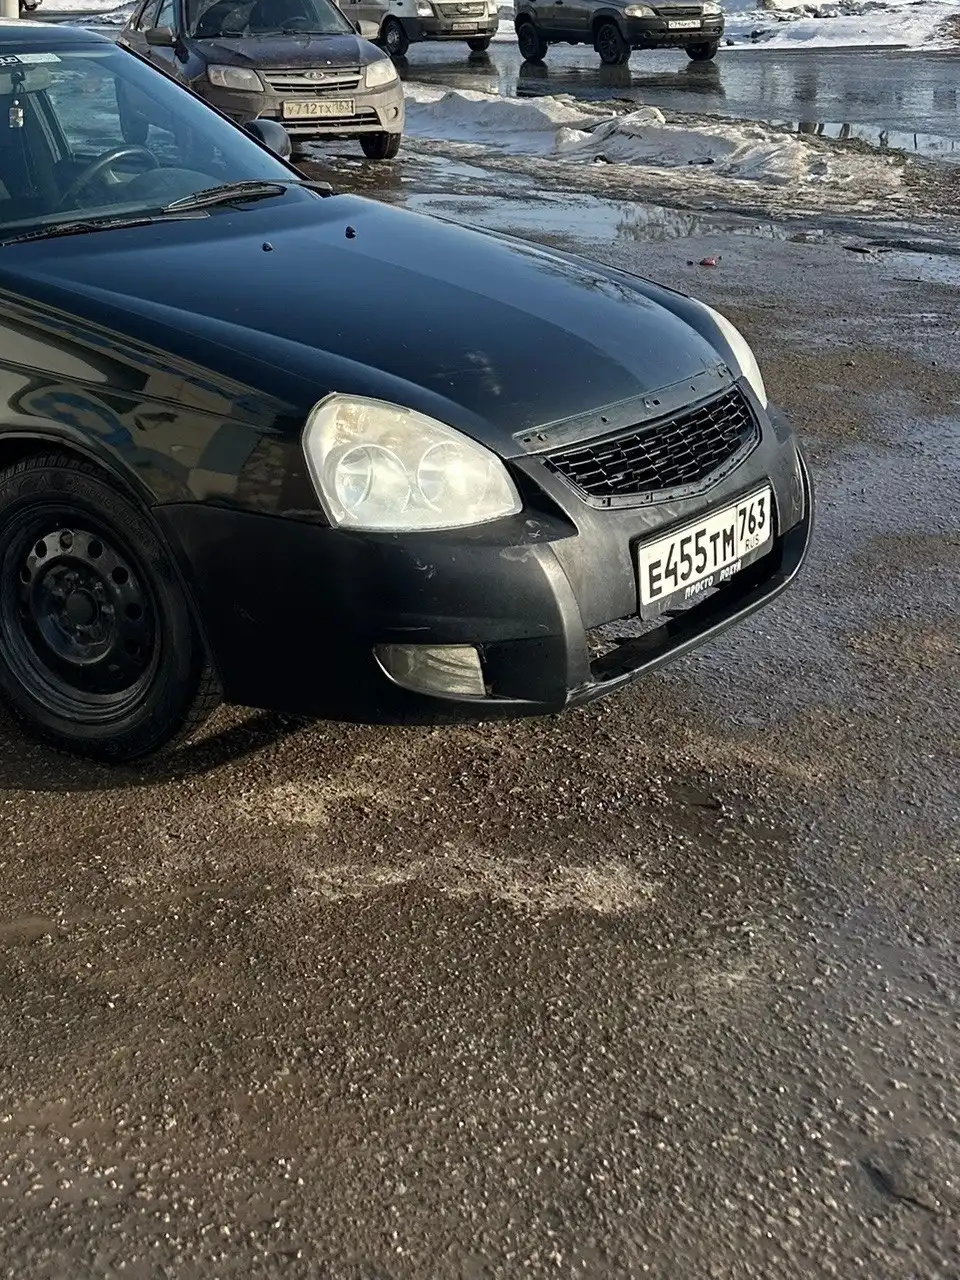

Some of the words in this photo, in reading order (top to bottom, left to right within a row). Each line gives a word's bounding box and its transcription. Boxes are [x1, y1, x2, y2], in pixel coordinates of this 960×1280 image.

[648, 524, 735, 599] Е455ТМ
[738, 497, 765, 542] 763
[744, 533, 760, 551] RUS
[684, 575, 714, 600] ПРОСТО
